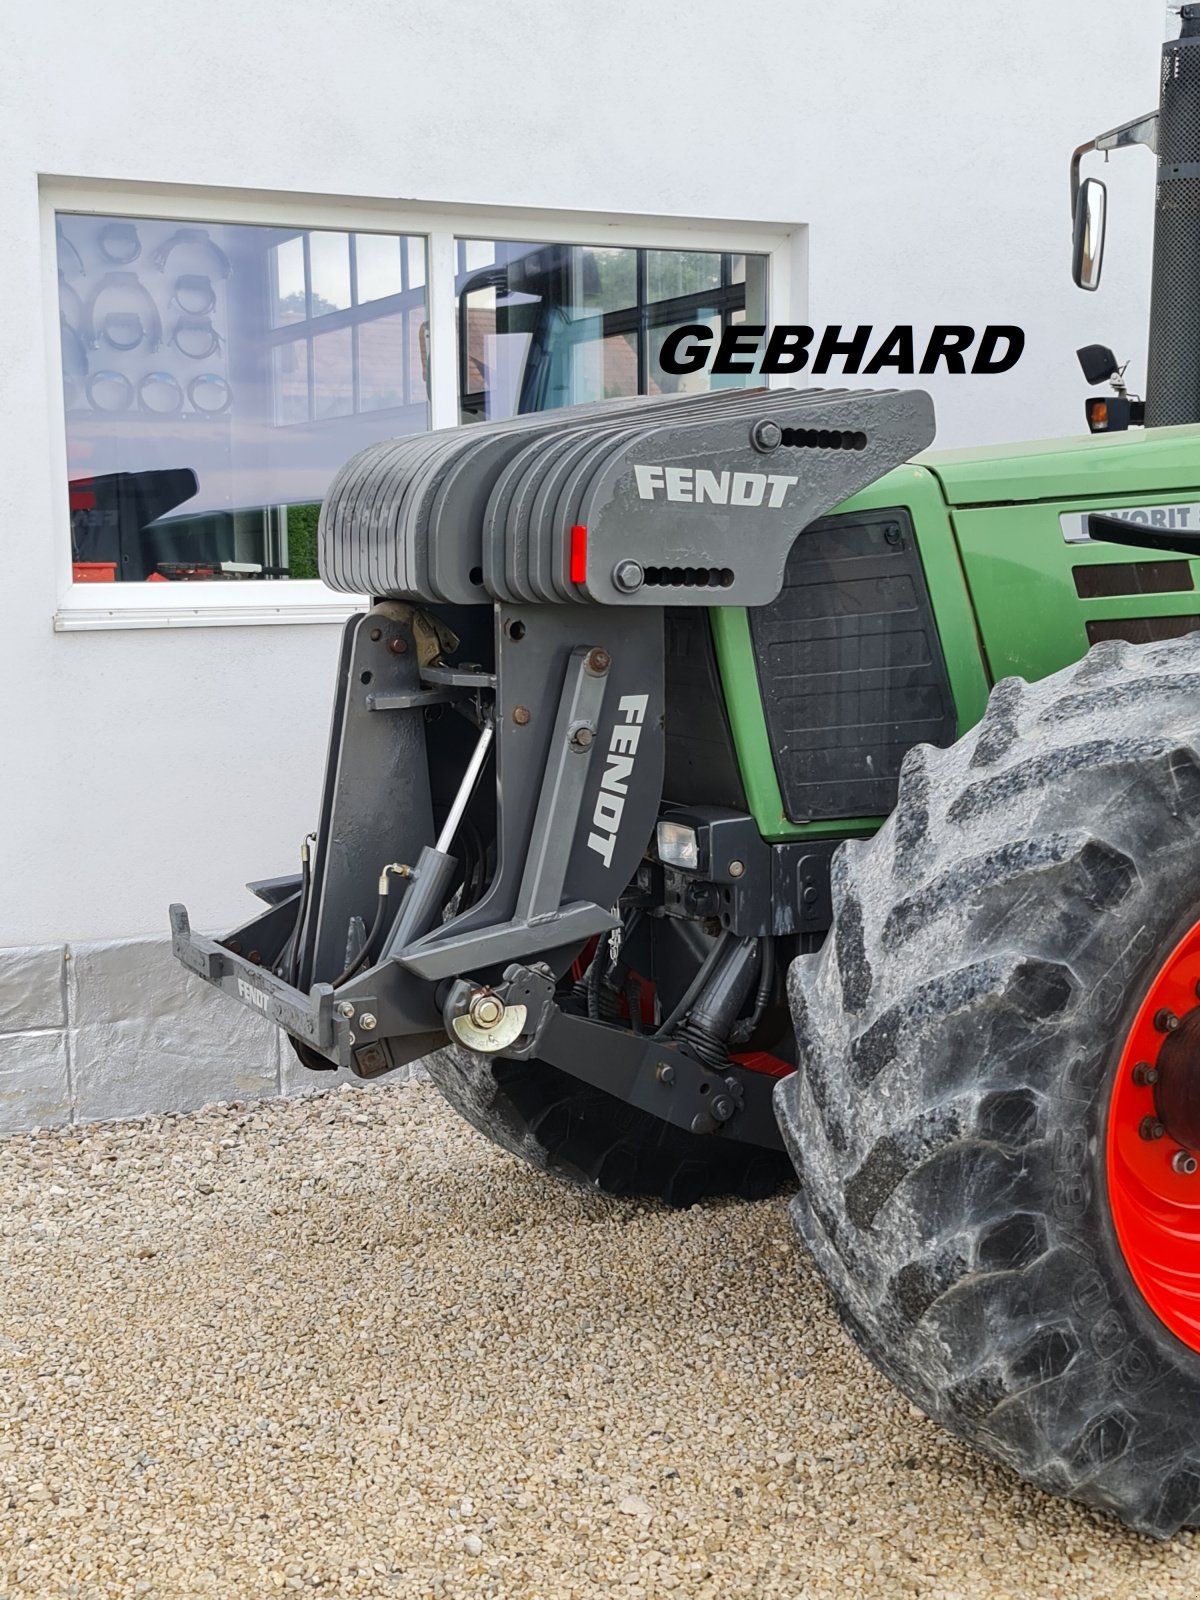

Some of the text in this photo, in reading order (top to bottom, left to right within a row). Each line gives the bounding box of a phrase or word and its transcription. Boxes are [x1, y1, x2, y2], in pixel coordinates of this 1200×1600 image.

[633, 464, 799, 508] FENDT
[587, 694, 649, 869] FENDT
[237, 978, 270, 1011] FENDT
